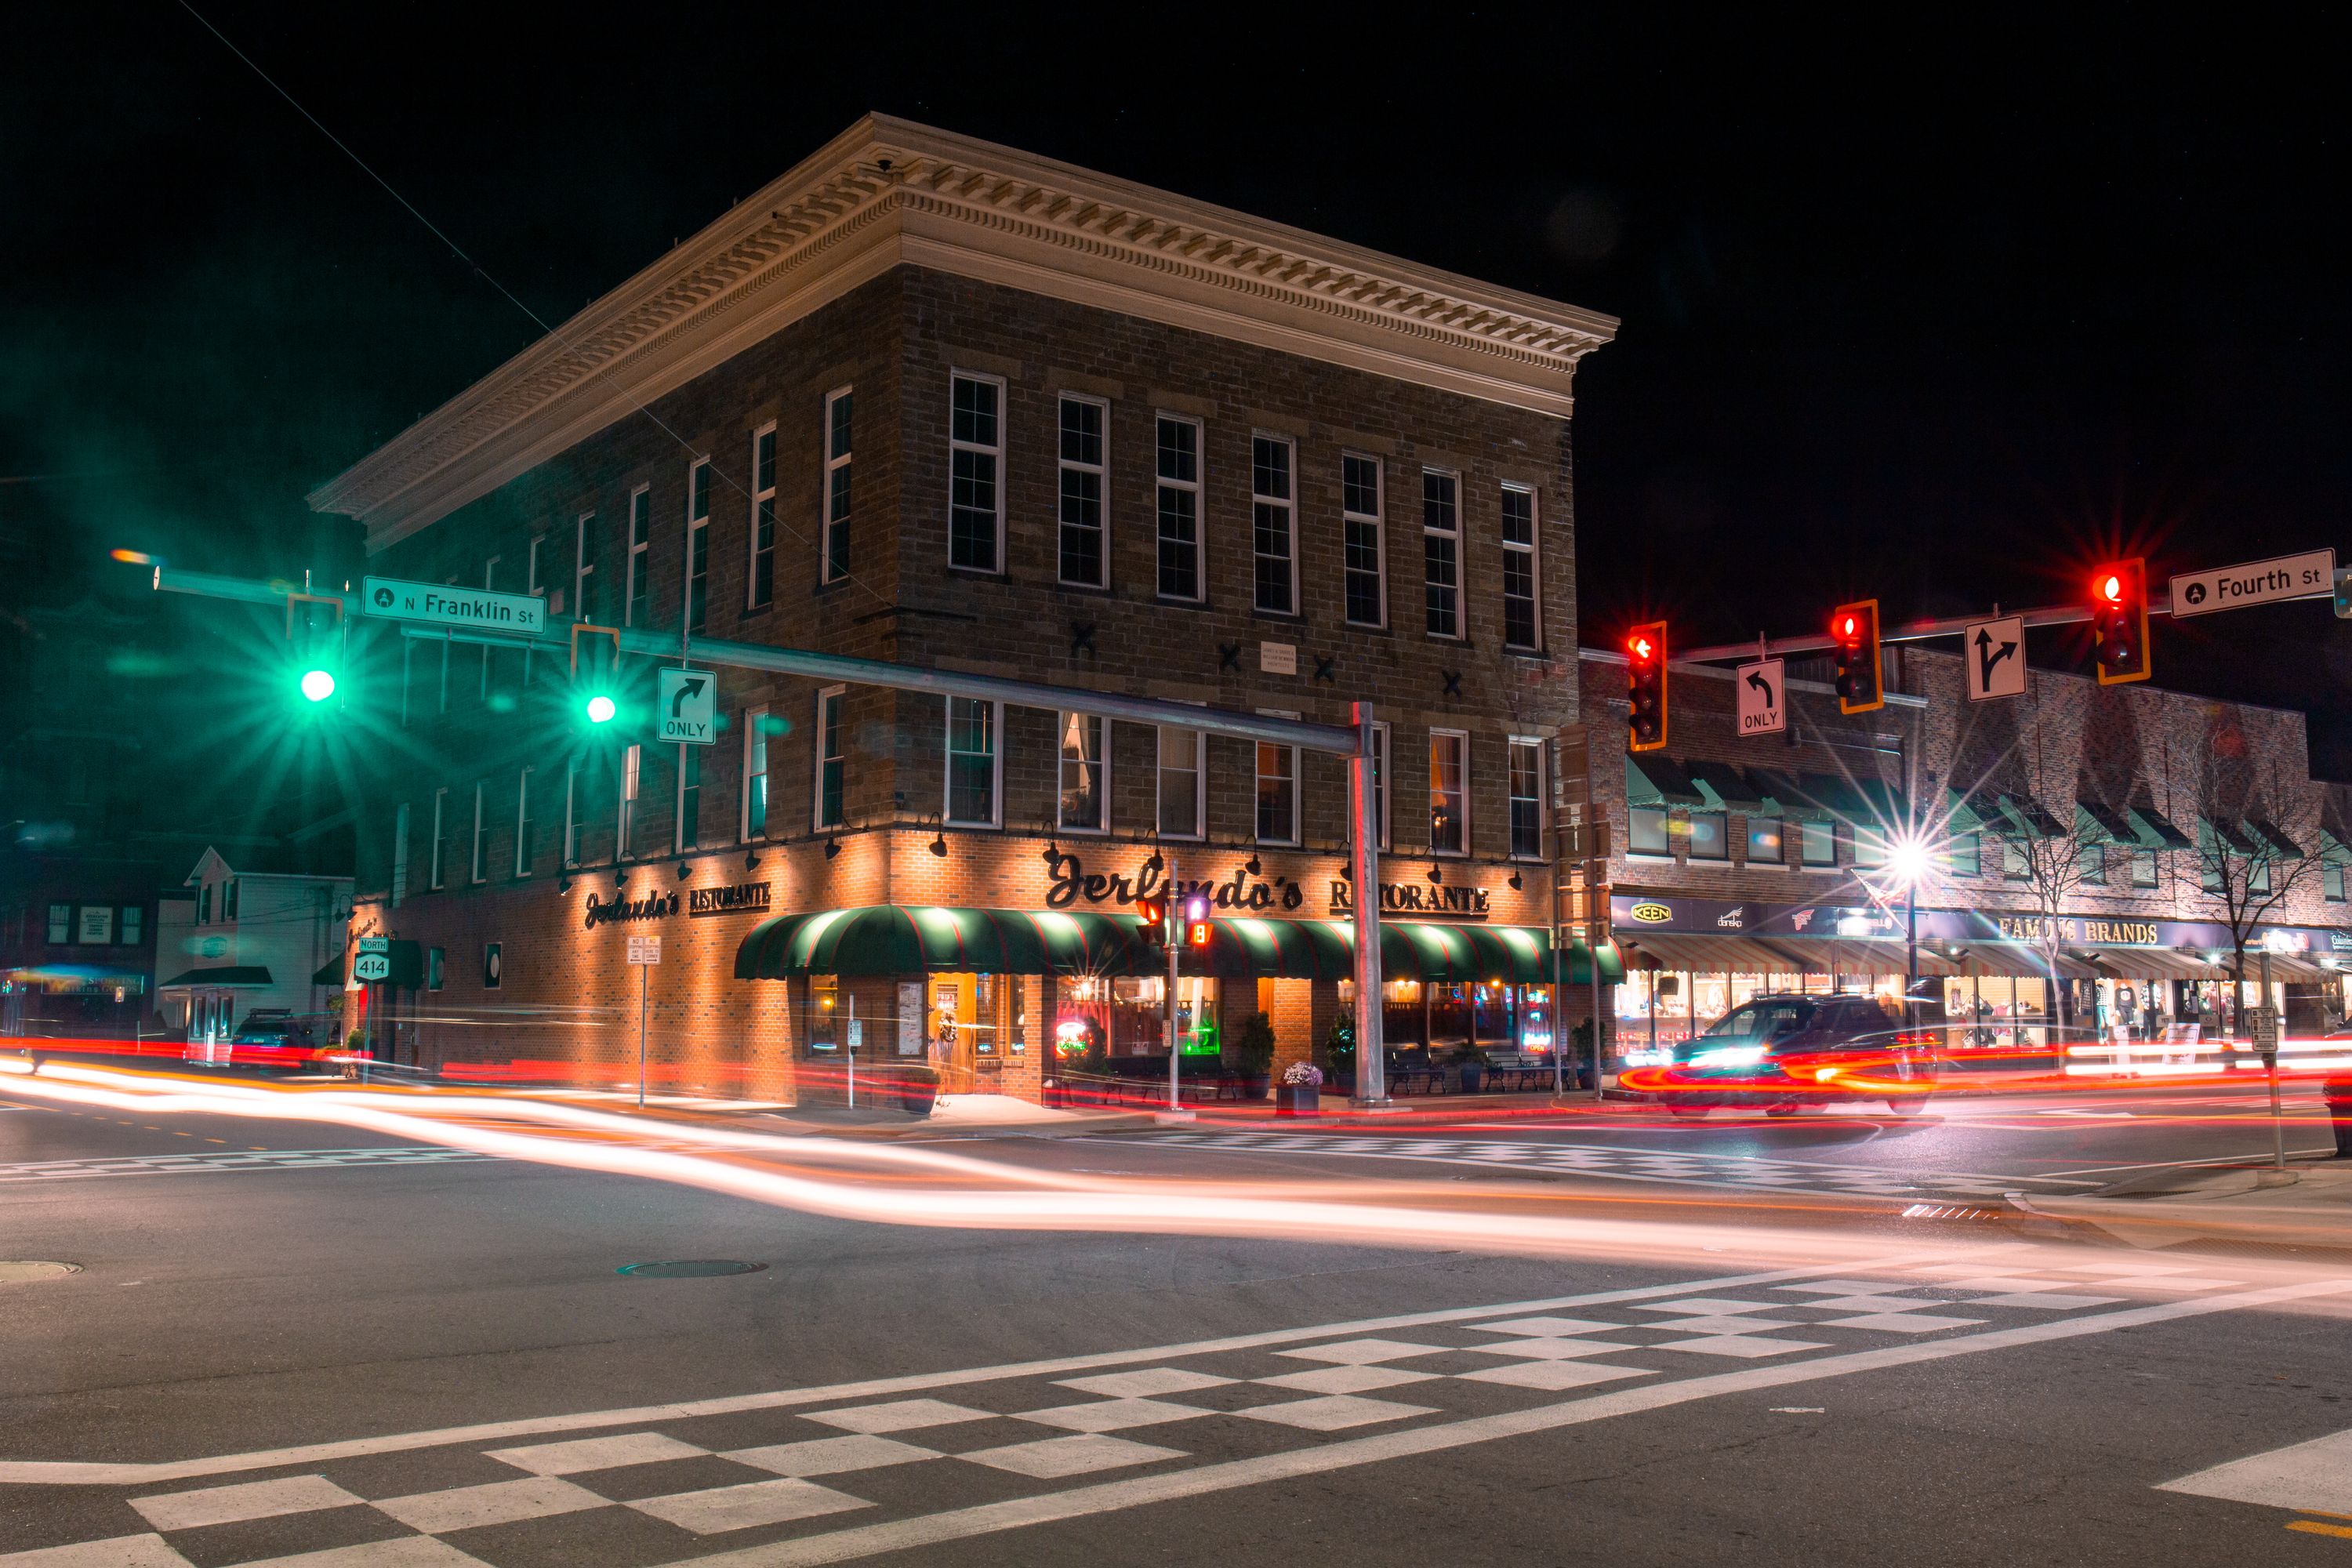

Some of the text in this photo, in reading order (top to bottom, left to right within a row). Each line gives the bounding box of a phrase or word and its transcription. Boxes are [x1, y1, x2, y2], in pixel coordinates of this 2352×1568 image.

[2218, 569, 2321, 599] Fourth St
[405, 593, 534, 623] N Franklin St
[1744, 711, 1777, 728] ONLY
[666, 721, 706, 737] ONLY
[690, 882, 771, 910] RISTORANTE
[1634, 906, 1669, 920] KEEN
[1999, 917, 2158, 945] FAMOUS BRANDS
[361, 940, 387, 950] NORTH
[359, 960, 386, 974] 414
